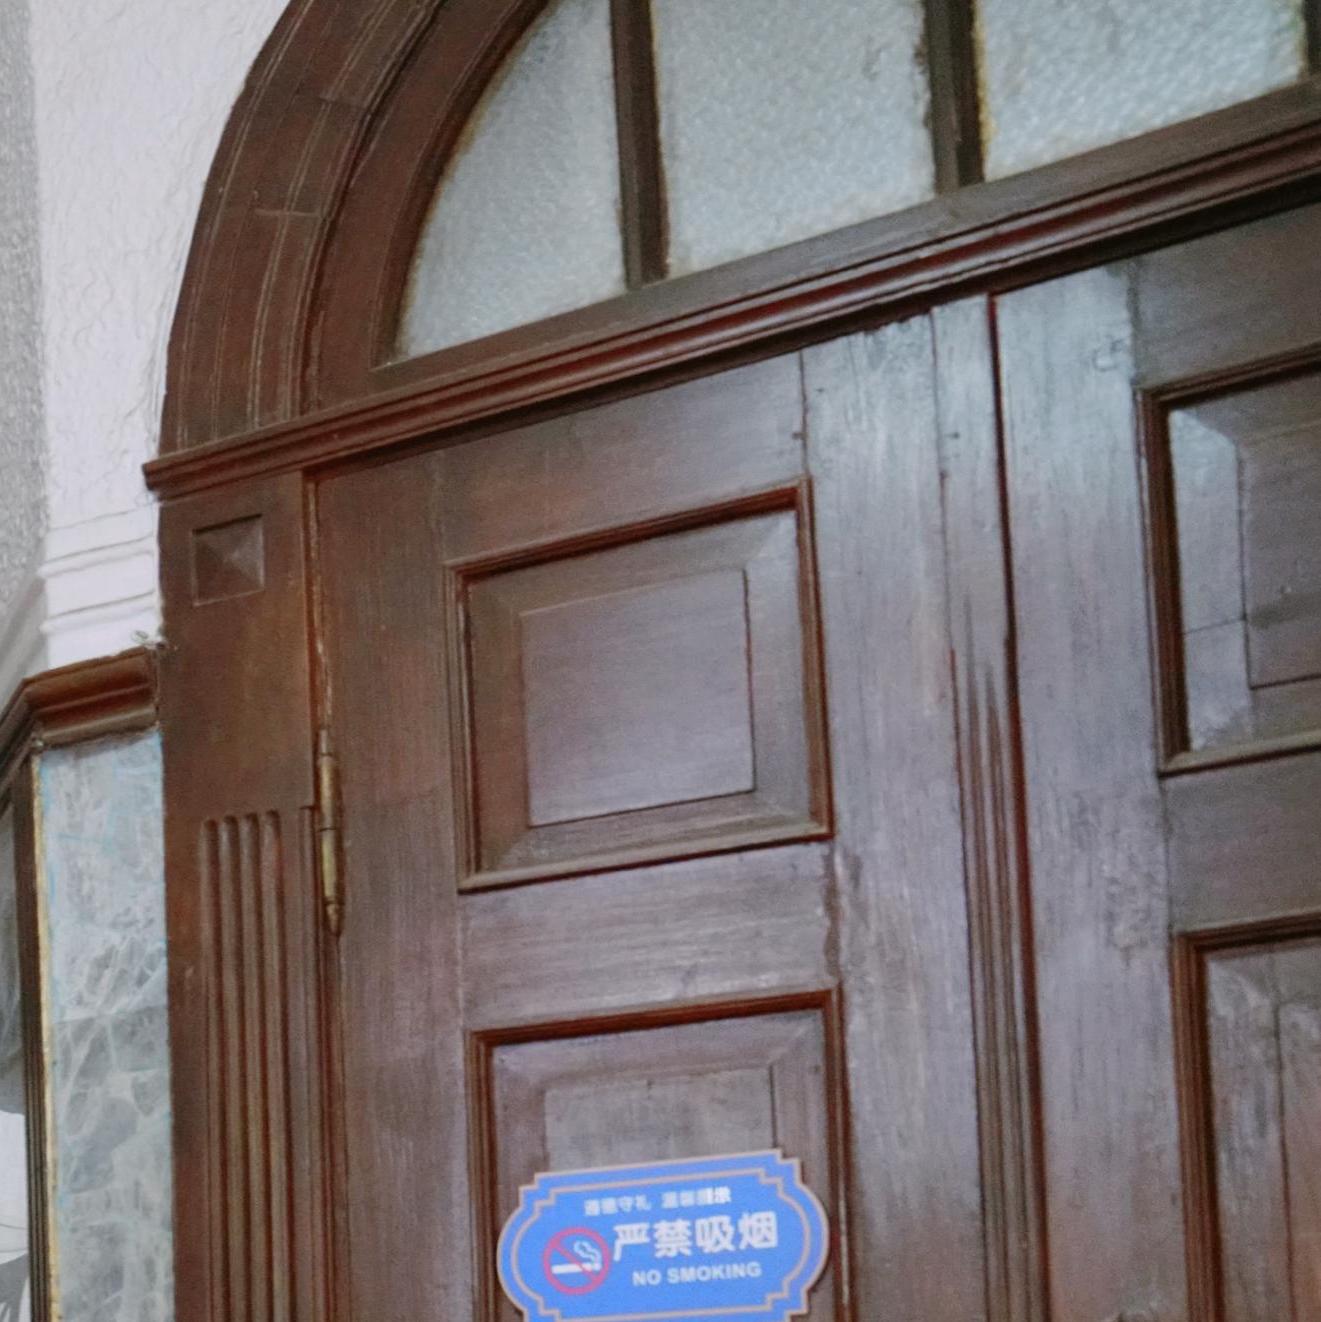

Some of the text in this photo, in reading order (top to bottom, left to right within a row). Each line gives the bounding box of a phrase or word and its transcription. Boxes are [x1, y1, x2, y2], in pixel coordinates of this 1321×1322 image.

[612, 1210, 779, 1263] 严禁吸烟
[632, 1261, 763, 1286] NO SMOKING
